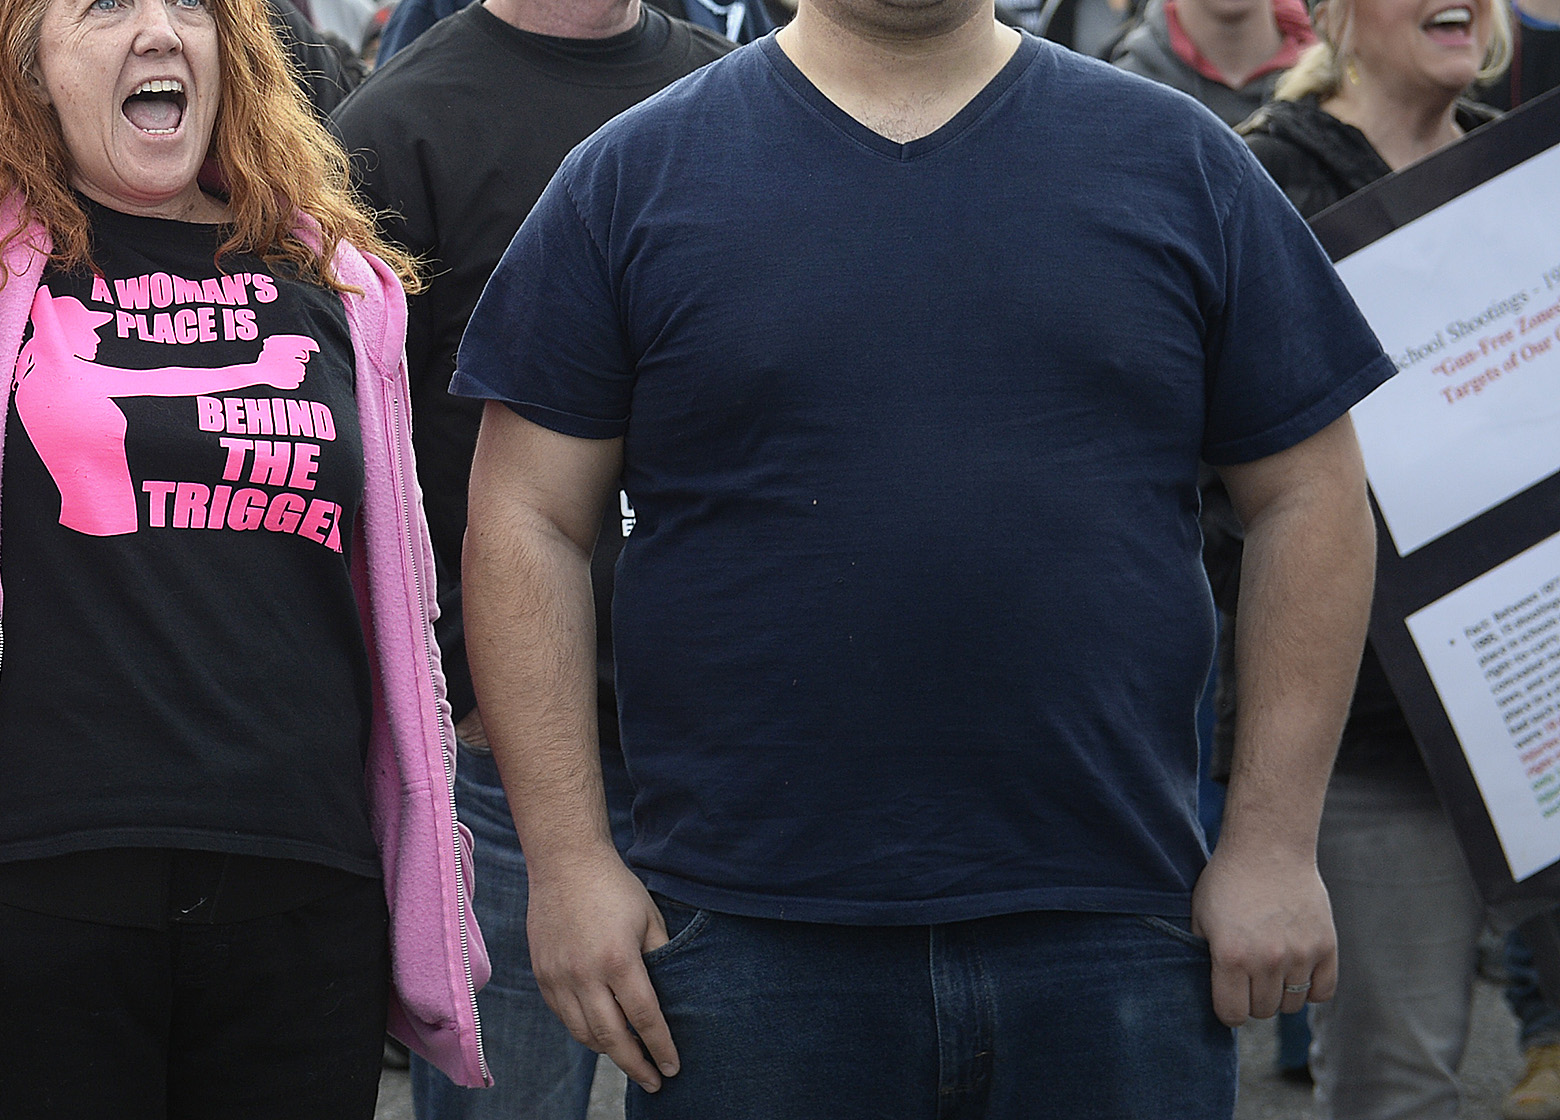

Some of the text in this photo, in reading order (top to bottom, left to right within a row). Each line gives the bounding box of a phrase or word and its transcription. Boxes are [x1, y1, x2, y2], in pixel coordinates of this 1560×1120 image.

[91, 272, 278, 310] A WOMAN'S
[115, 307, 259, 344] PLACE IS
[196, 395, 337, 442] BEHIND
[219, 437, 321, 491] THE
